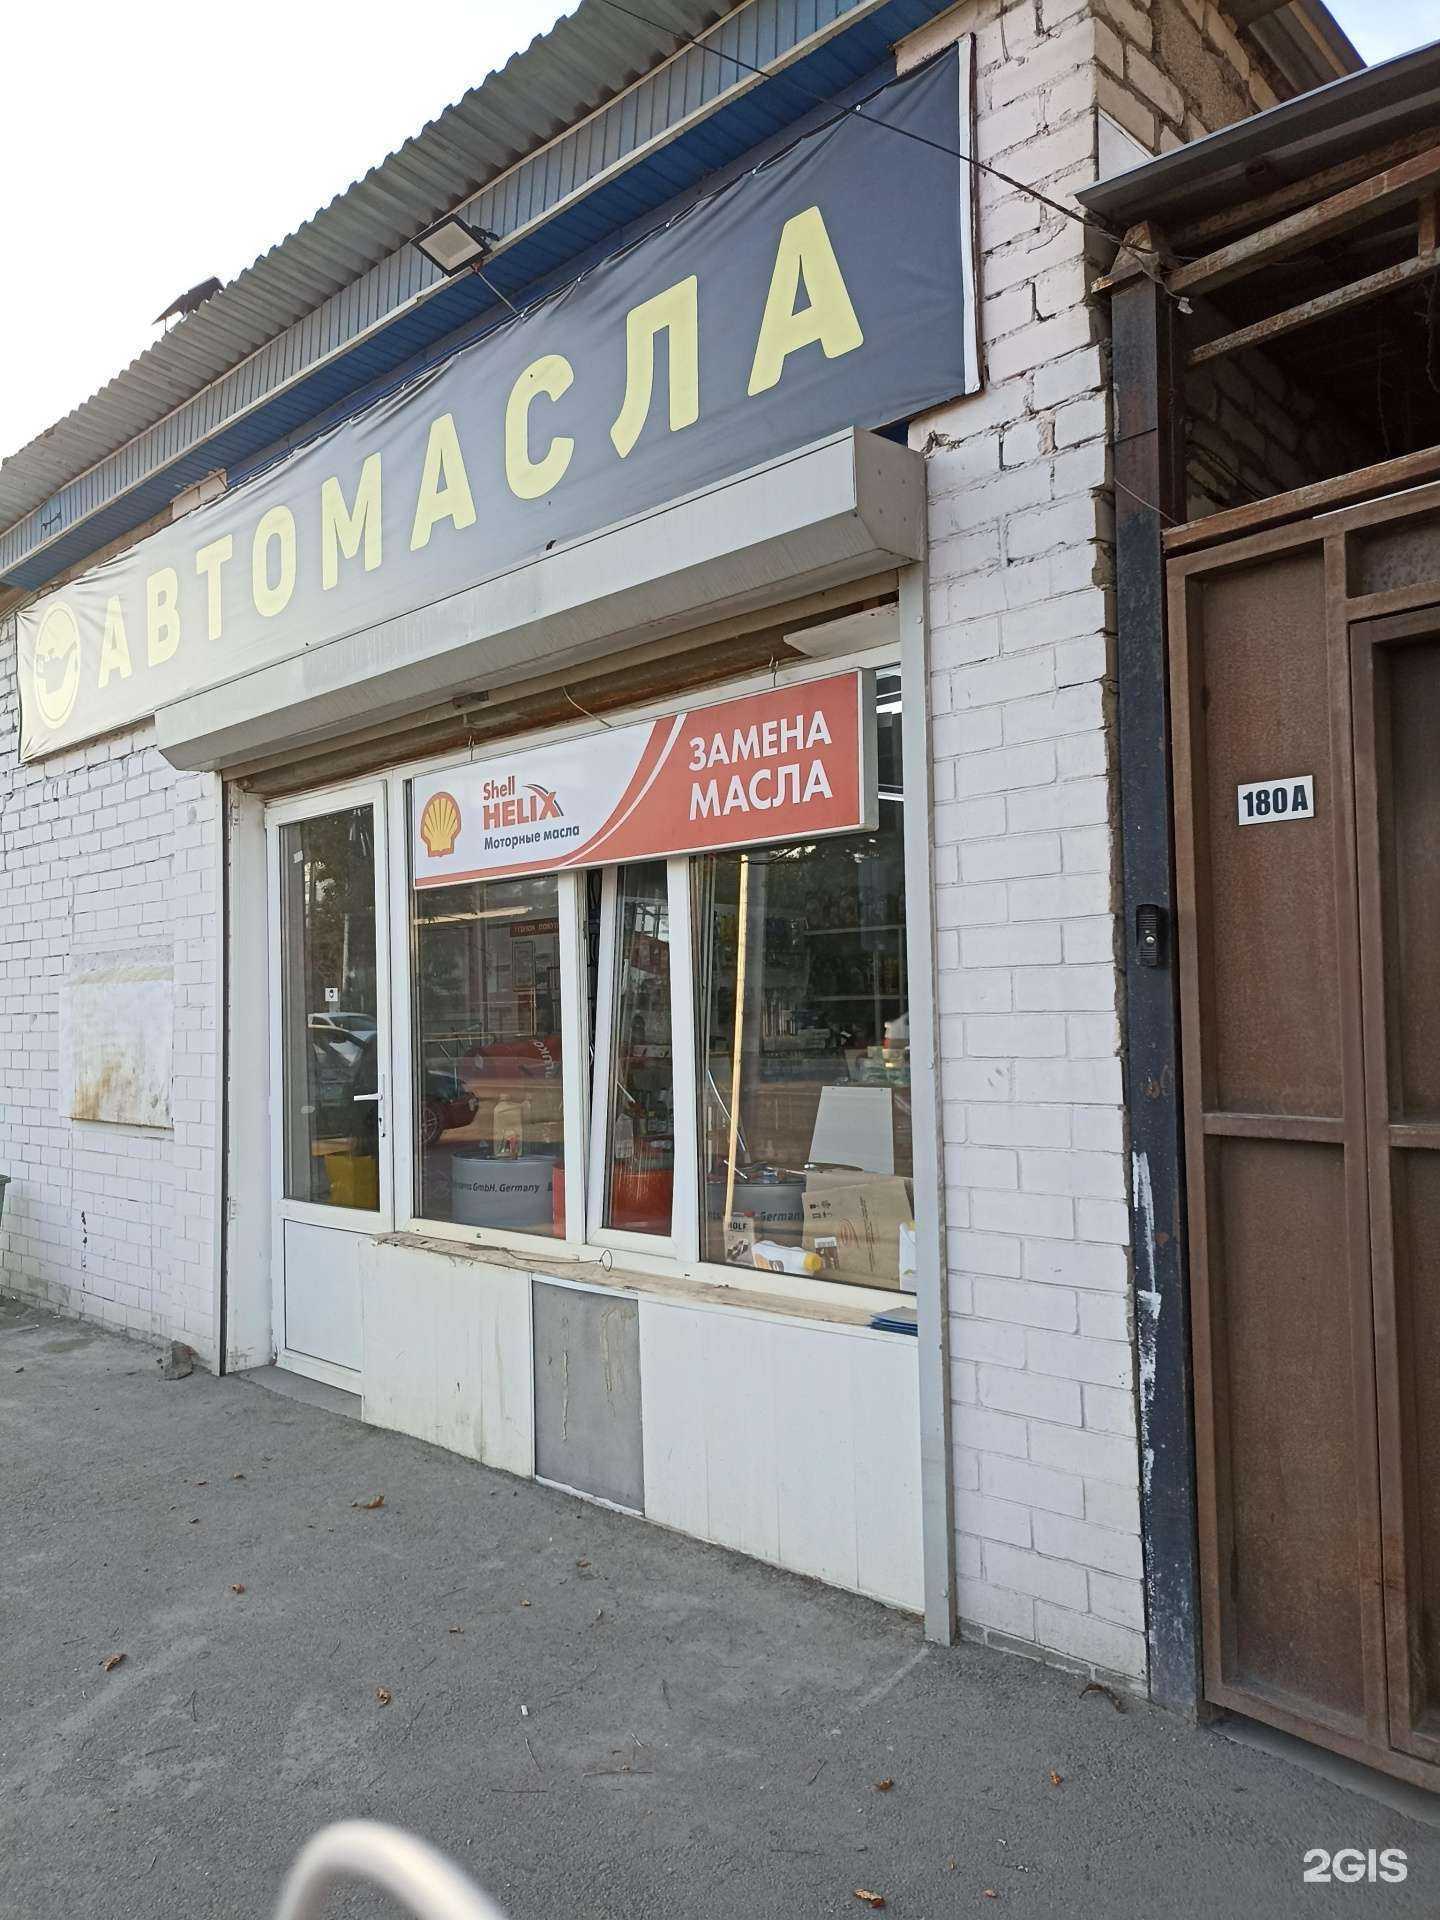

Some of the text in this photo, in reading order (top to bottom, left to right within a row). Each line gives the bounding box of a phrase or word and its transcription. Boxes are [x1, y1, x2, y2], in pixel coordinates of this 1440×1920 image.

[98, 206, 864, 688] АВТОМАСЛА
[689, 710, 832, 771] ЗАМЕНА
[483, 775, 515, 801] Shell
[689, 759, 833, 820] МАСЛА
[1242, 784, 1309, 817] 180А
[482, 788, 562, 830] HELIX
[484, 825, 580, 850] Моторные масла
[499, 1182, 540, 1194] Germany
[760, 1211, 801, 1222] German
